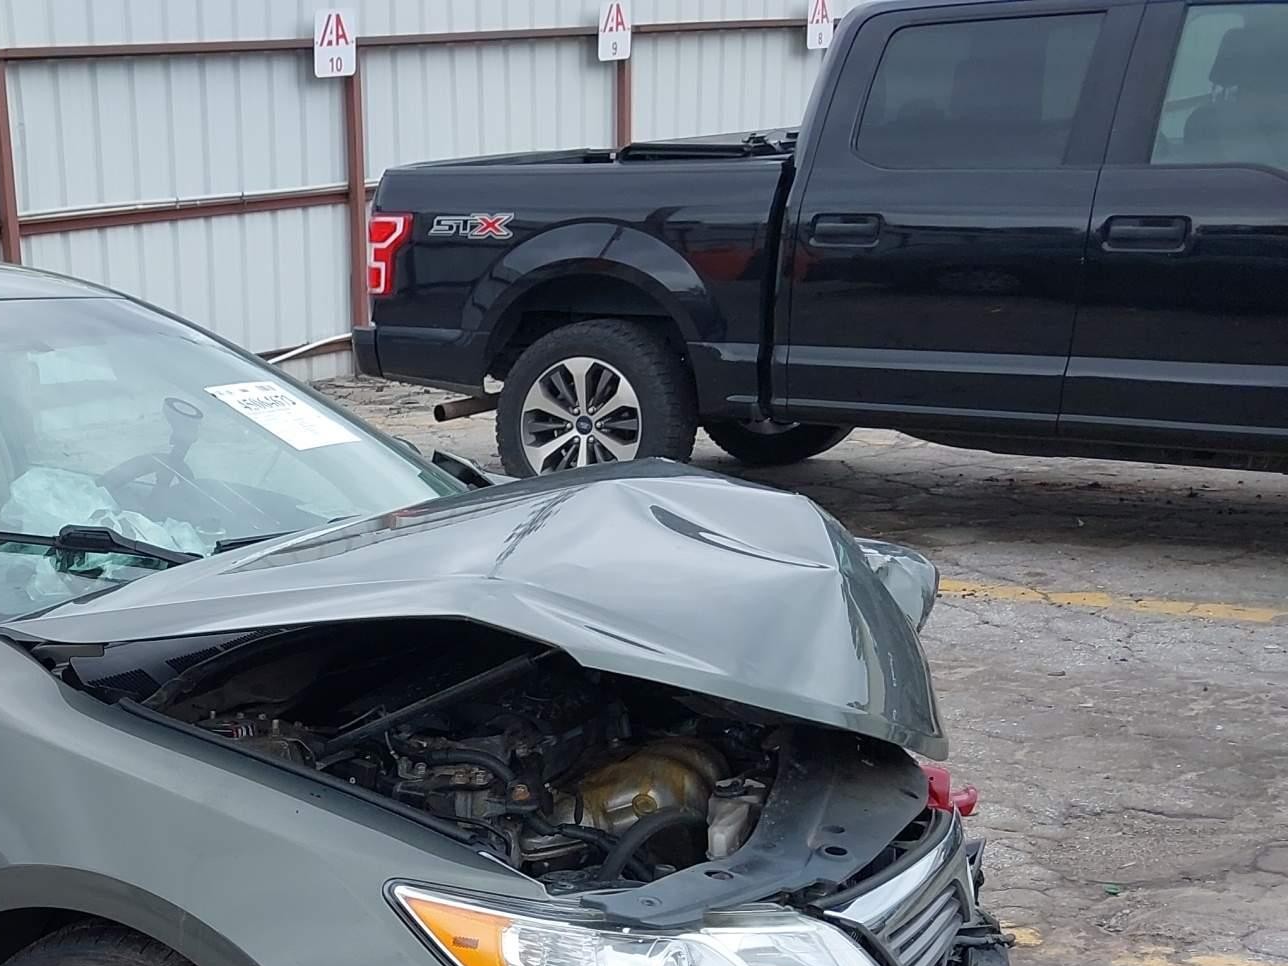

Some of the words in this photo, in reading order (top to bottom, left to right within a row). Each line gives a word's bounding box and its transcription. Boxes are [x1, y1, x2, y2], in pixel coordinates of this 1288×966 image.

[818, 32, 823, 46] 8
[612, 41, 618, 56] 9
[329, 57, 343, 73] 10
[428, 212, 514, 239] STX
